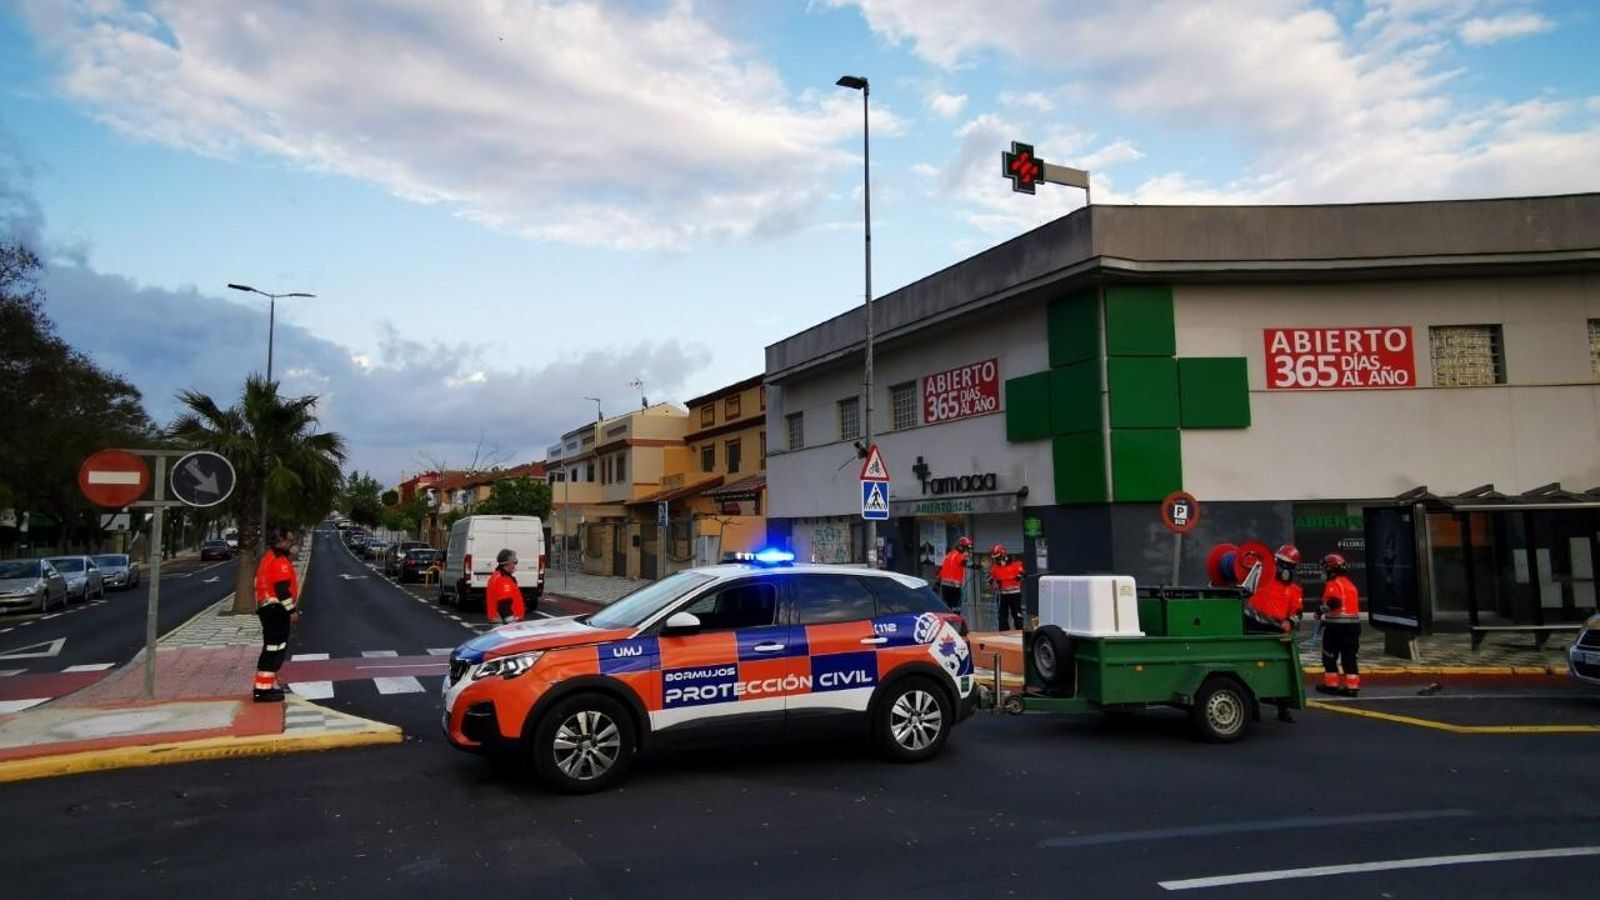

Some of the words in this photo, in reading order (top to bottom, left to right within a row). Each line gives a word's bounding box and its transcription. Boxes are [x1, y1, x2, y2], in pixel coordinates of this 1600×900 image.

[1270, 328, 1408, 355] ABIERTO
[926, 361, 995, 395] ABIERTO
[1274, 354, 1339, 388] 365
[1341, 353, 1380, 371] DÍAS
[1341, 370, 1364, 387] AL
[1368, 366, 1409, 386] AÑO
[927, 391, 960, 422] 365
[960, 386, 981, 402] DÍAS
[960, 401, 973, 416] AL
[974, 396, 995, 412] AÑO
[1176, 506, 1185, 517] P
[878, 622, 897, 633] 112
[612, 646, 643, 658] UMJ
[665, 665, 736, 682] BORMUJOS
[664, 672, 813, 704] PROTECCIÓN
[818, 668, 874, 687] CIVIL
